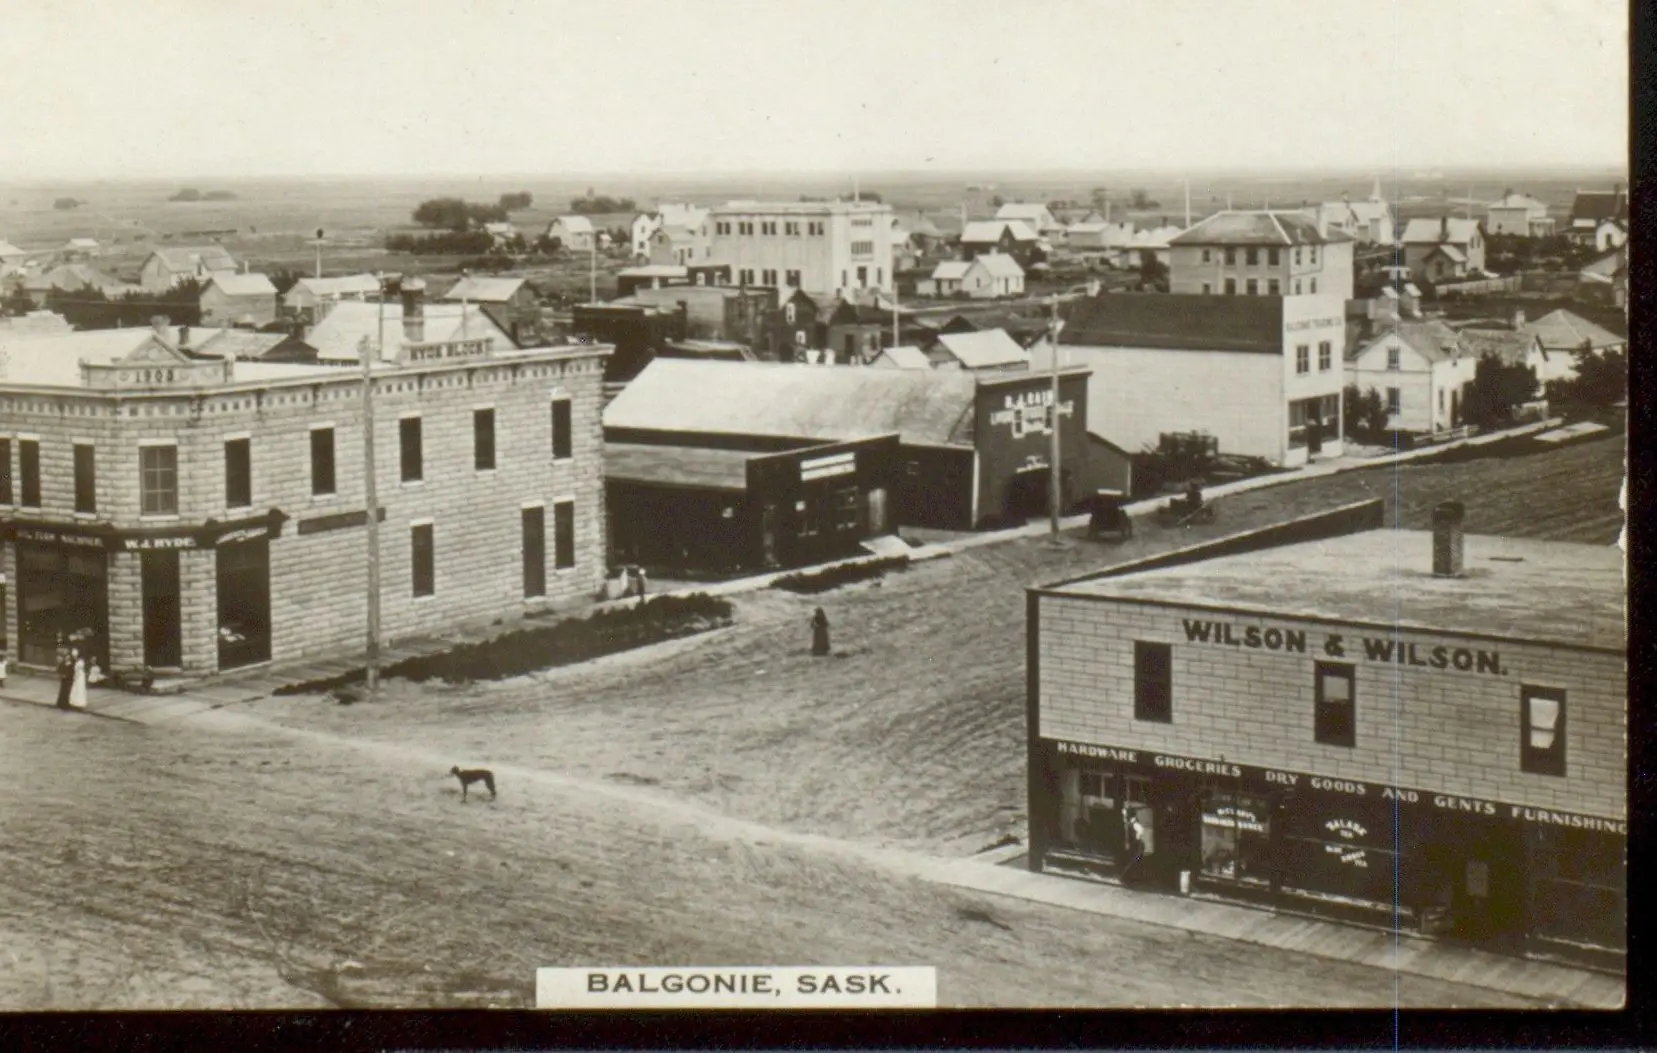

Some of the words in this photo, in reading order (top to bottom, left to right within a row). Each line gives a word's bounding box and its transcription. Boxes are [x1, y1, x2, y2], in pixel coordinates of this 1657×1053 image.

[1183, 618, 1307, 653] WILSON
[1323, 633, 1346, 658] &
[1362, 637, 1509, 676] WILSON.
[1056, 741, 1138, 763] HARDWARE
[1154, 754, 1242, 777] GROCERIES
[1264, 769, 1299, 786] DRY
[1310, 776, 1367, 796] GOODS
[1381, 786, 1420, 803] AND
[1433, 795, 1497, 816] GENTS
